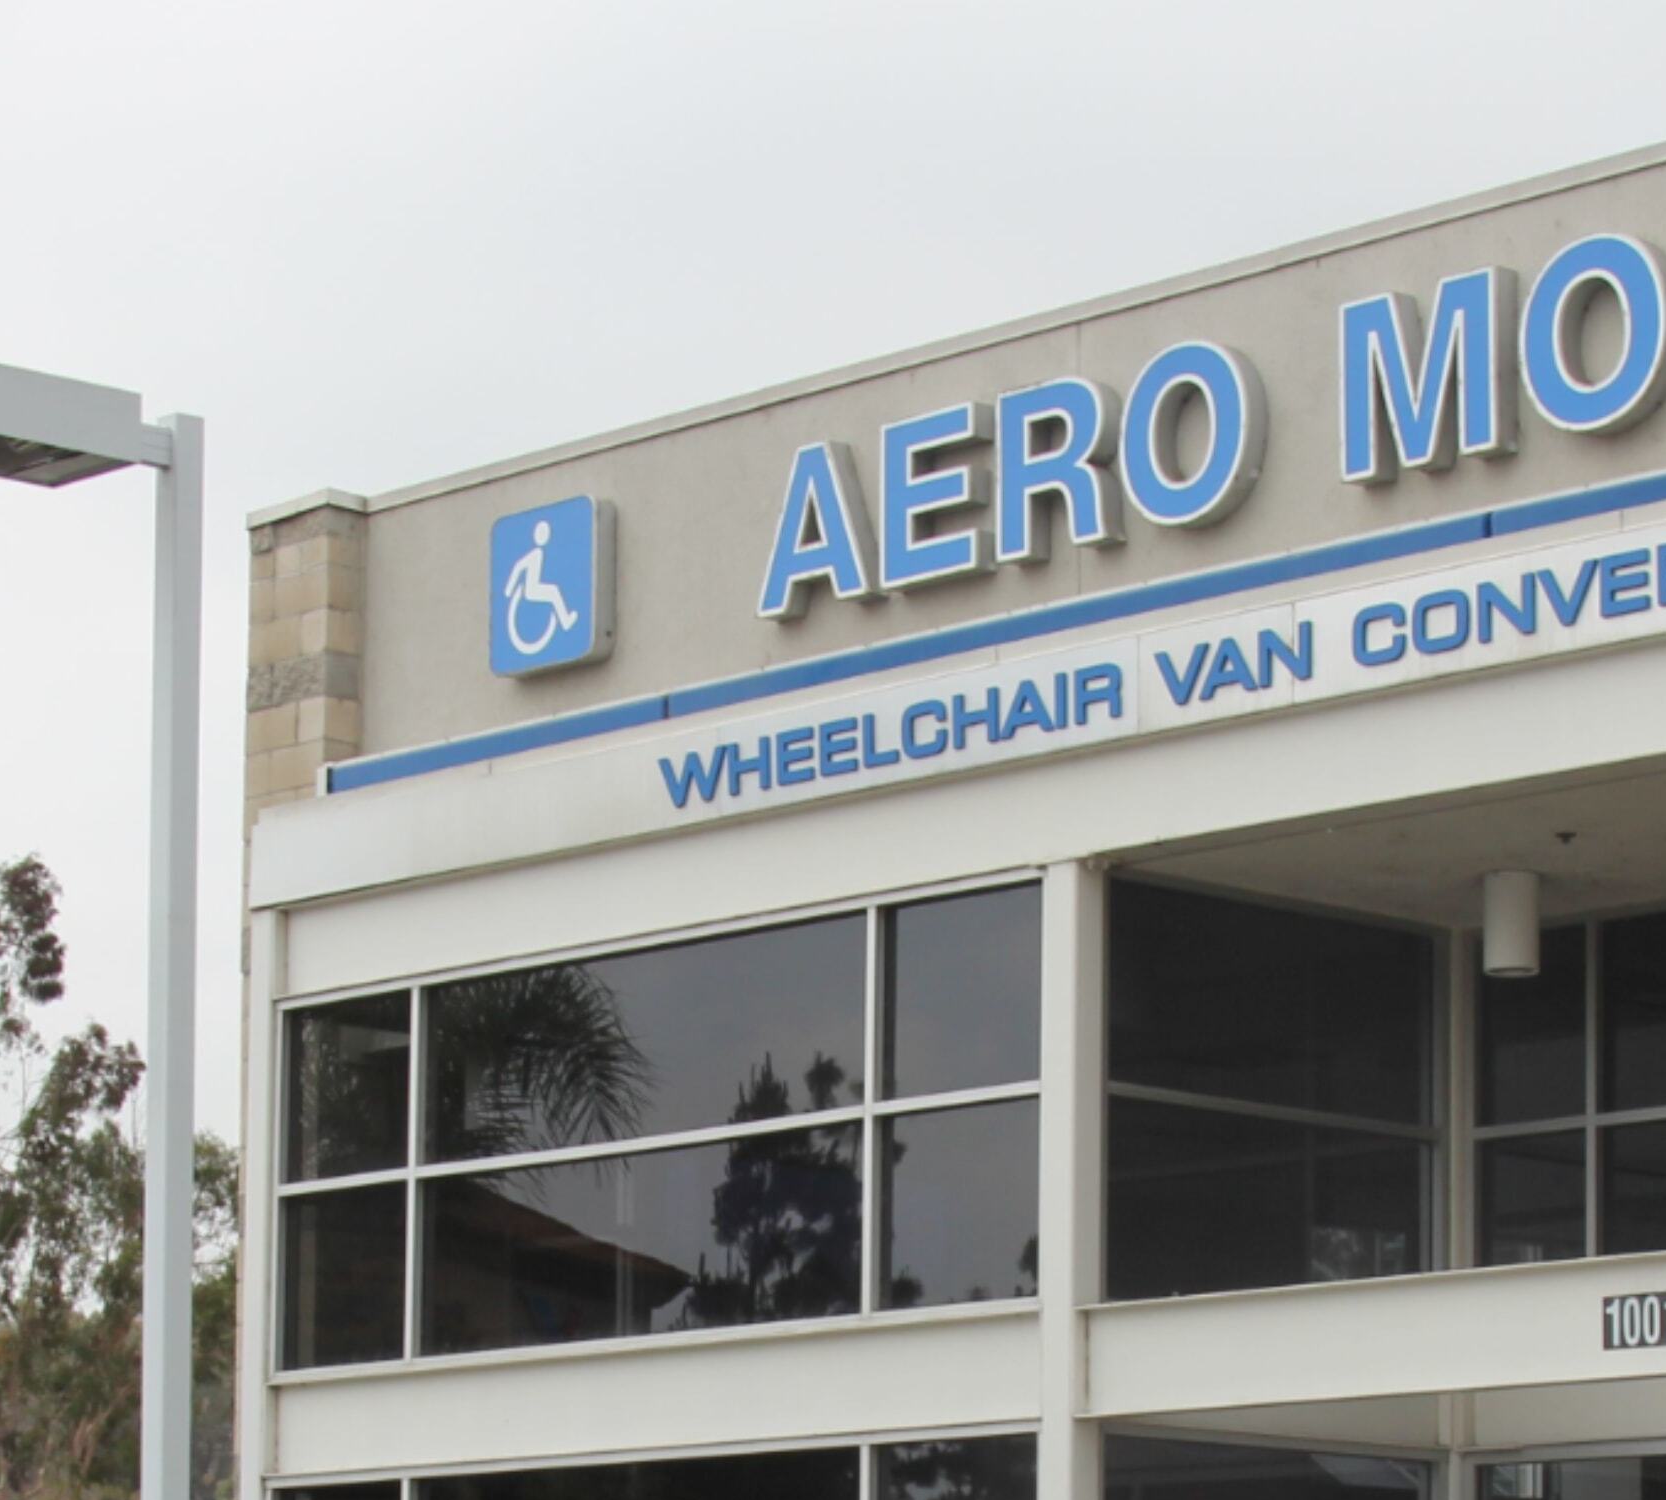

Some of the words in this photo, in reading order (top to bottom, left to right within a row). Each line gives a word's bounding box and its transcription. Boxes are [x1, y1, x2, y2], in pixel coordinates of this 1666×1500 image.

[757, 339, 1265, 620] AERO
[658, 663, 1122, 808] WHEELCHAIR
[1154, 620, 1313, 706] VAN
